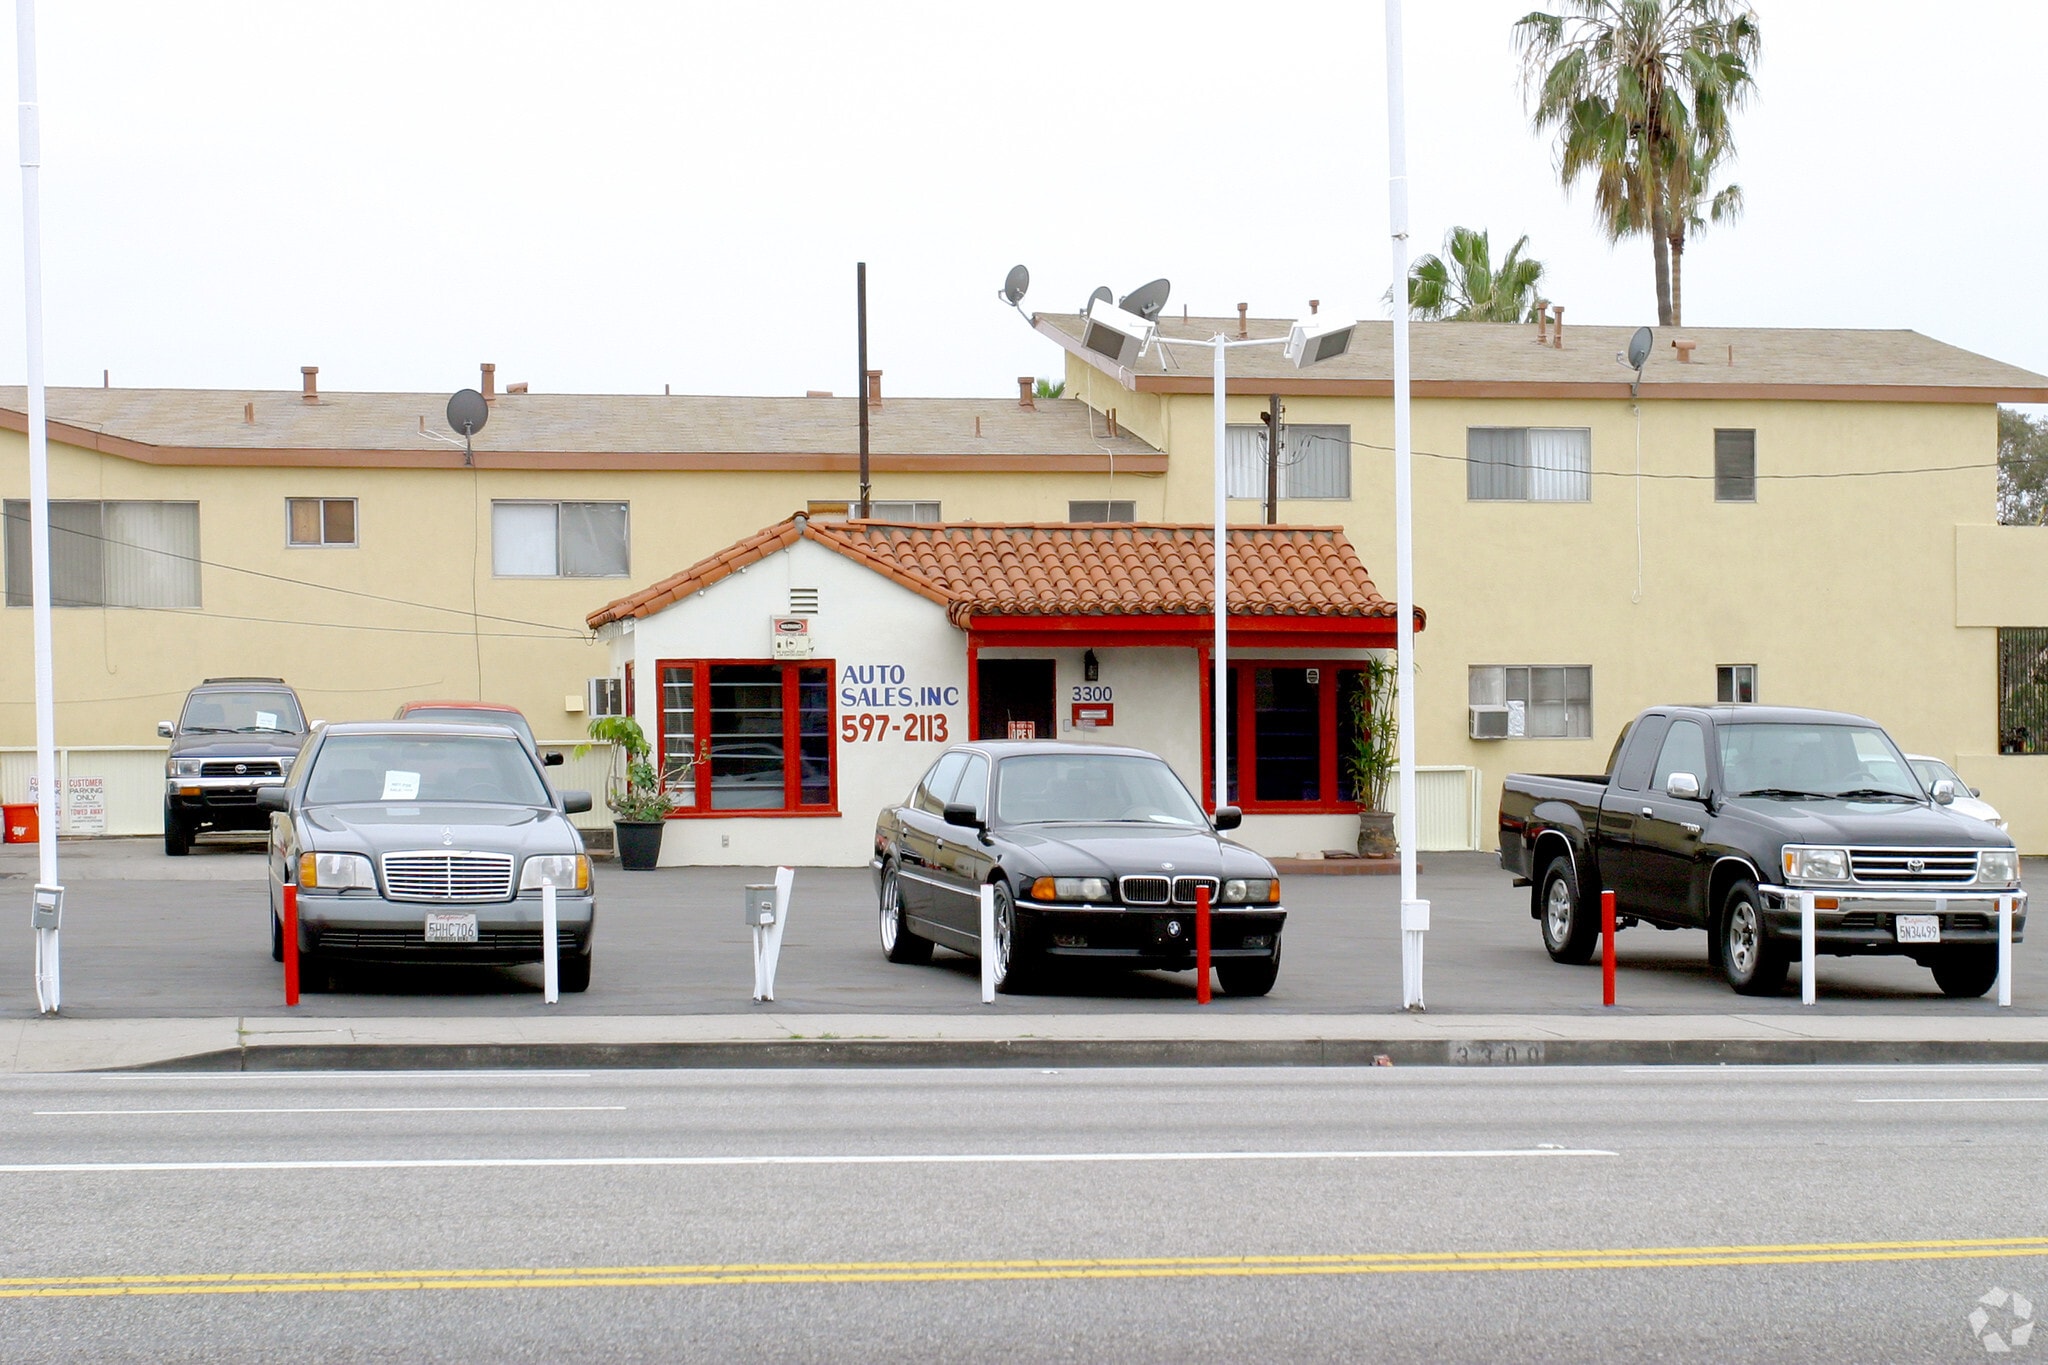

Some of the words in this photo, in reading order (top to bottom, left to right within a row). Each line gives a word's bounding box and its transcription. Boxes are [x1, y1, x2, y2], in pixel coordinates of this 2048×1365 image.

[841, 665, 905, 685] AUTO
[1072, 686, 1113, 702] 3300
[841, 713, 949, 743] 597-2113
[69, 779, 103, 788] CUSTOMER
[69, 787, 103, 795] PARKING
[428, 922, 474, 937] 5HHC706
[1900, 925, 1937, 940] 5N34499
